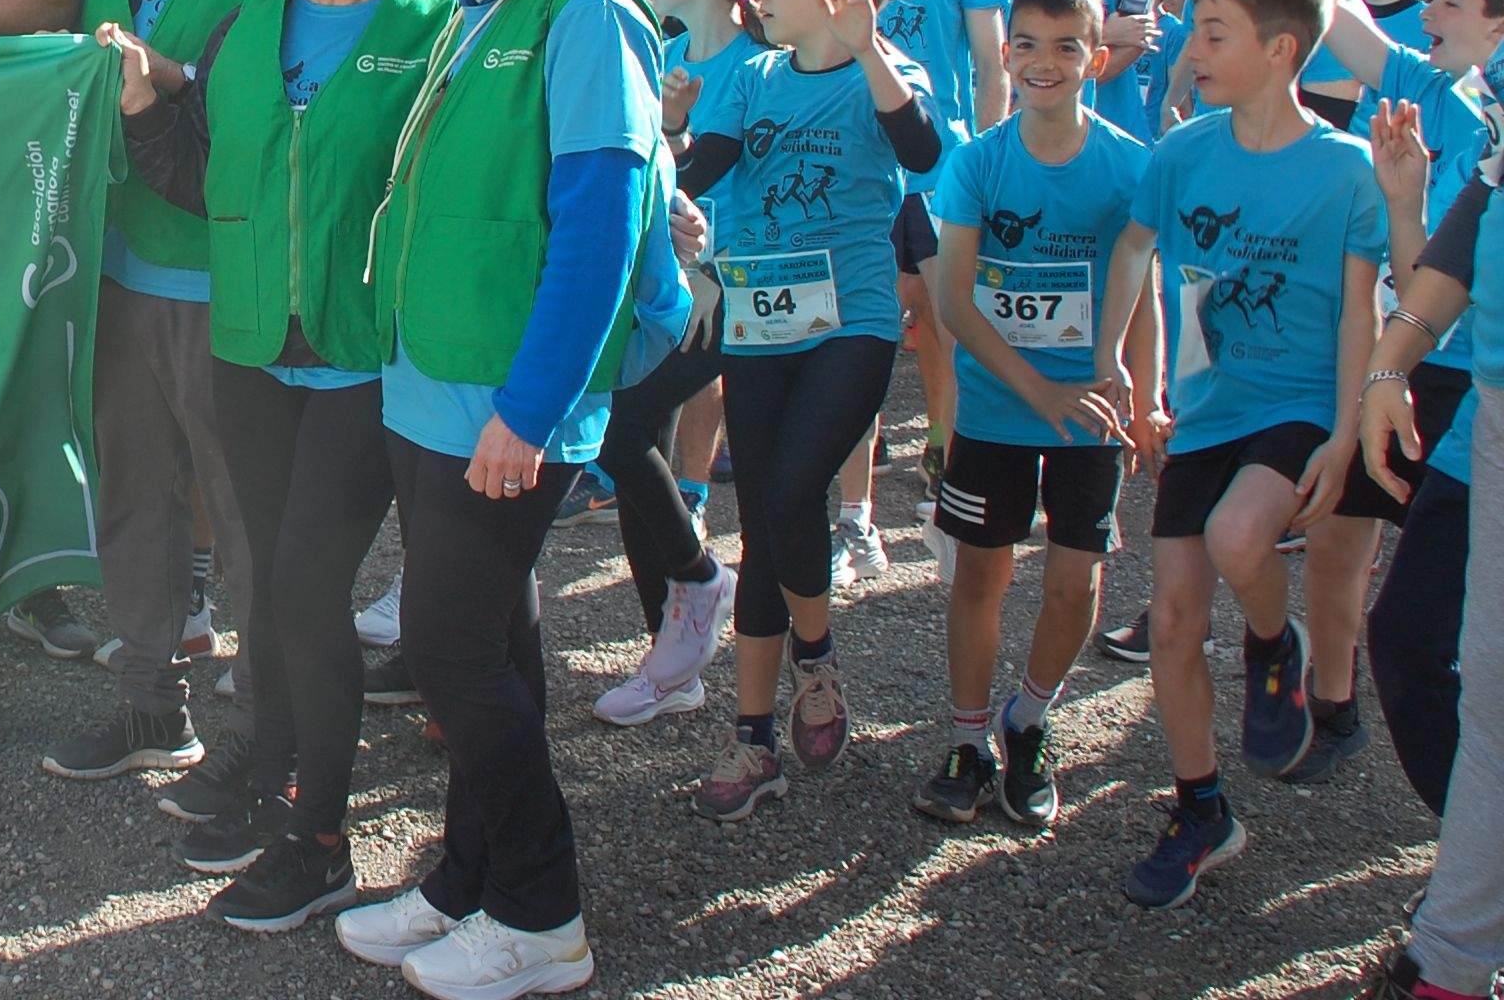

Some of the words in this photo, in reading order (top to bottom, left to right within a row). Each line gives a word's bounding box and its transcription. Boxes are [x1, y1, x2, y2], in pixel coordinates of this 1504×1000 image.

[25, 140, 45, 246] asociación
[1037, 227, 1097, 245] Carrera
[1233, 227, 1299, 248] Carrera
[1032, 243, 1098, 258] solidaria
[1226, 244, 1298, 263] solidaria
[753, 288, 796, 318] 64
[994, 292, 1063, 321] 367
